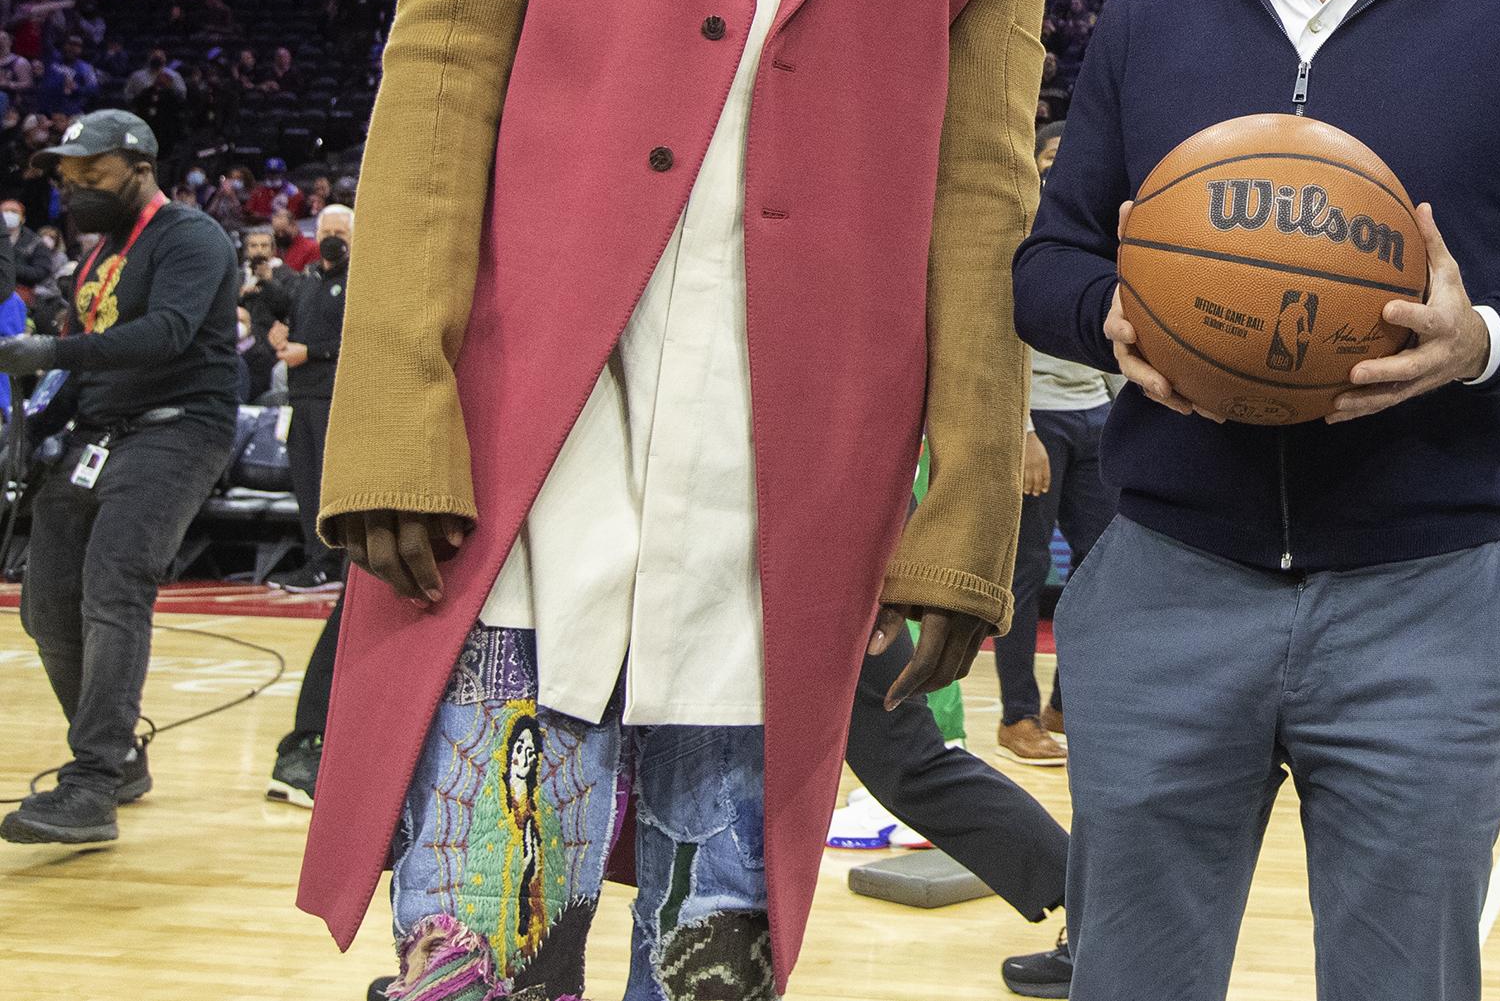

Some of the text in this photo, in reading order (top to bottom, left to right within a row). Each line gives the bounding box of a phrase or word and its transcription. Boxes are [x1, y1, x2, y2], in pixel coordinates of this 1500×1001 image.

[1206, 178, 1405, 272] Wilson
[1194, 296, 1265, 331] OFFICIAL GAME BALL
